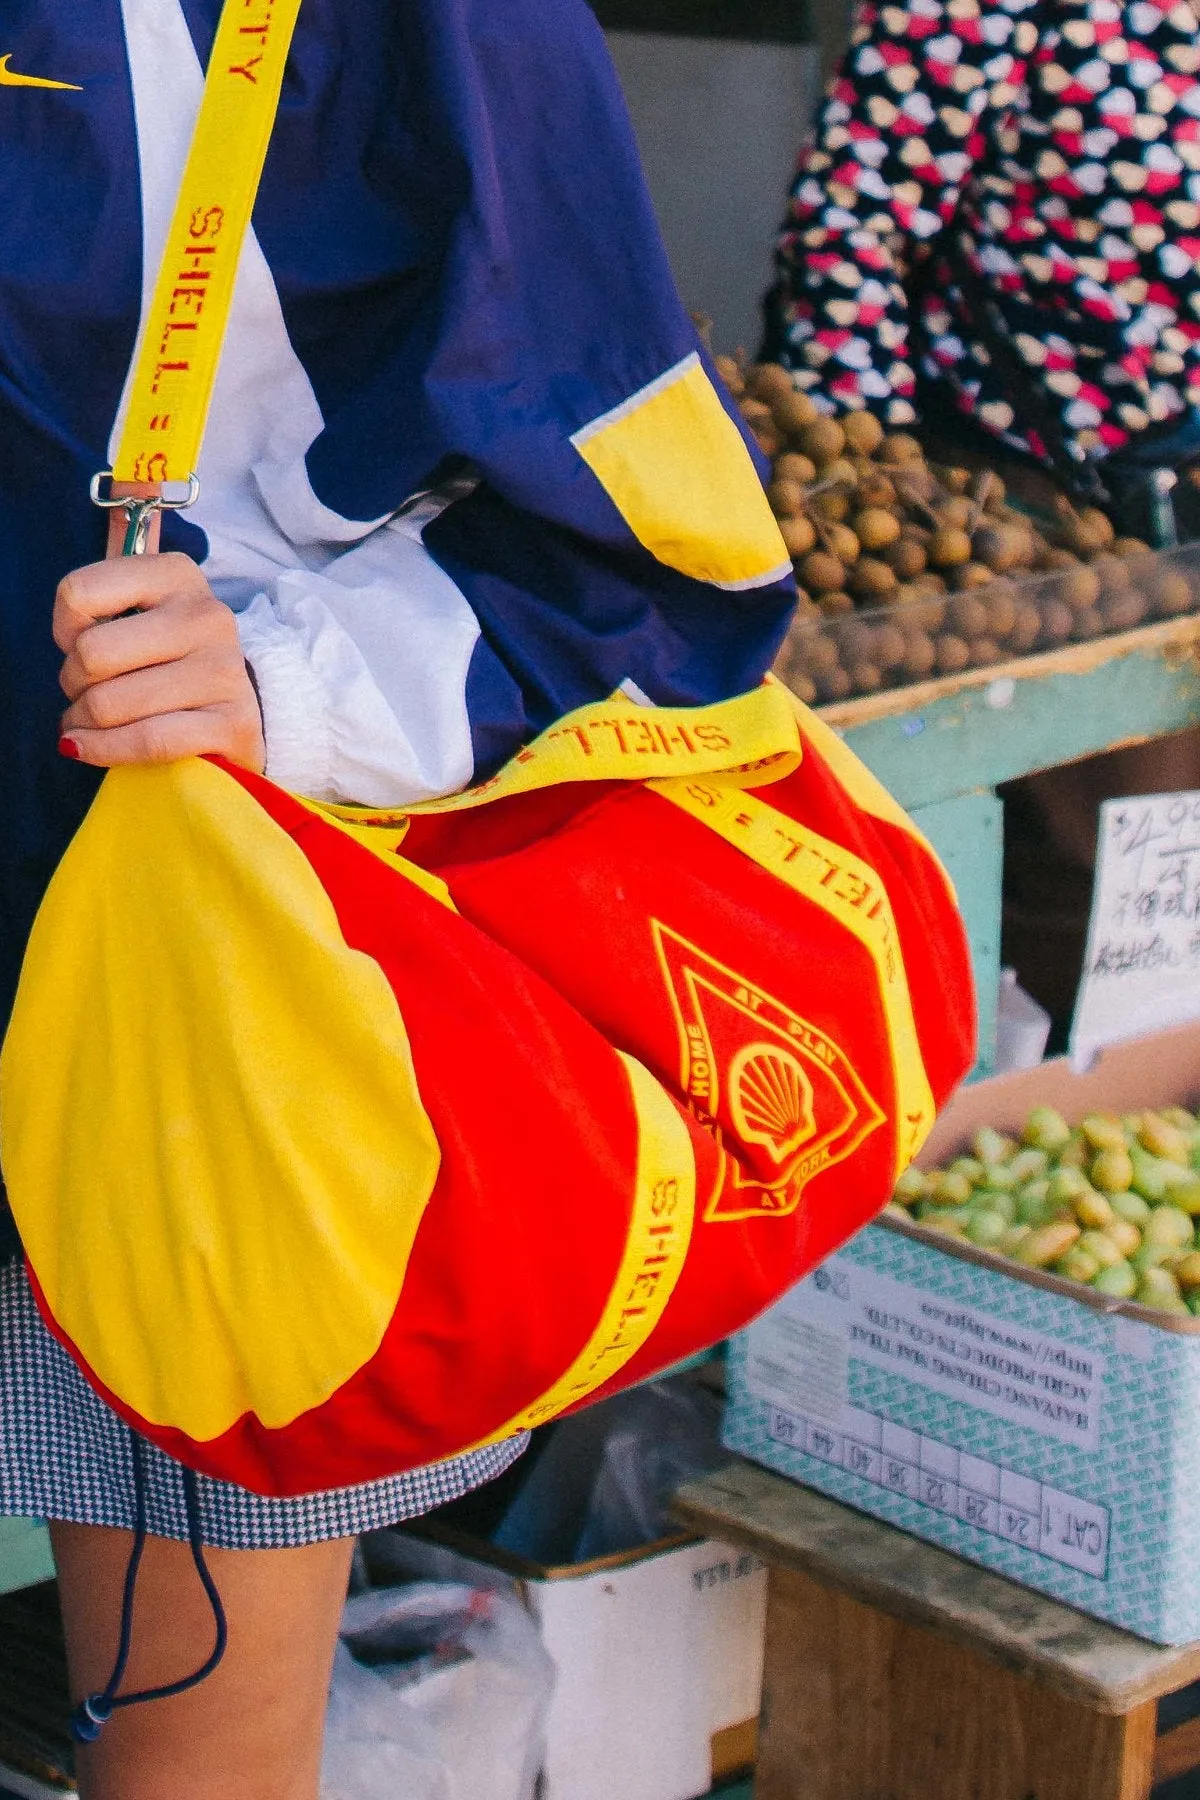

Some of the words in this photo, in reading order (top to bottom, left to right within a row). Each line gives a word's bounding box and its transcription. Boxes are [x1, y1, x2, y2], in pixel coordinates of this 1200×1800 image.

[150, 203, 225, 395] SHELL
[548, 719, 731, 757] SHELL
[687, 1024, 711, 1098] HOME
[735, 987, 764, 1011] AT
[788, 1019, 837, 1066] PLAY
[760, 1188, 788, 1208] AT
[588, 1175, 678, 1373] SHELL
[1006, 1510, 1030, 1543] 24
